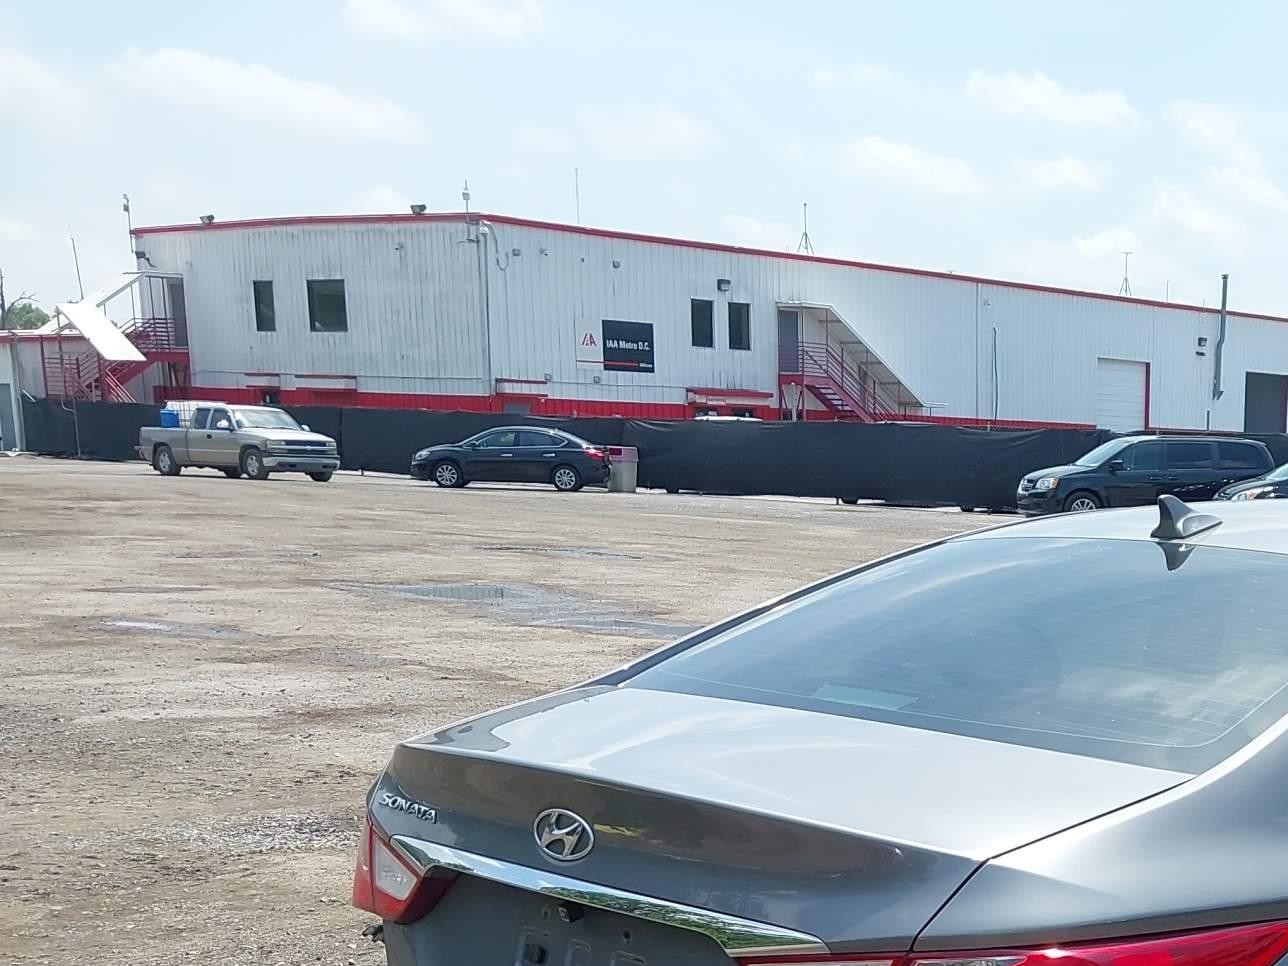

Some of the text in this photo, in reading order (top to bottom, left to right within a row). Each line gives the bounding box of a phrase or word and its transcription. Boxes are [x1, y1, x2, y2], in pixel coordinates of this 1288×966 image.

[606, 339, 651, 351] IAA Metro D.C.
[379, 792, 438, 824] SONATA
